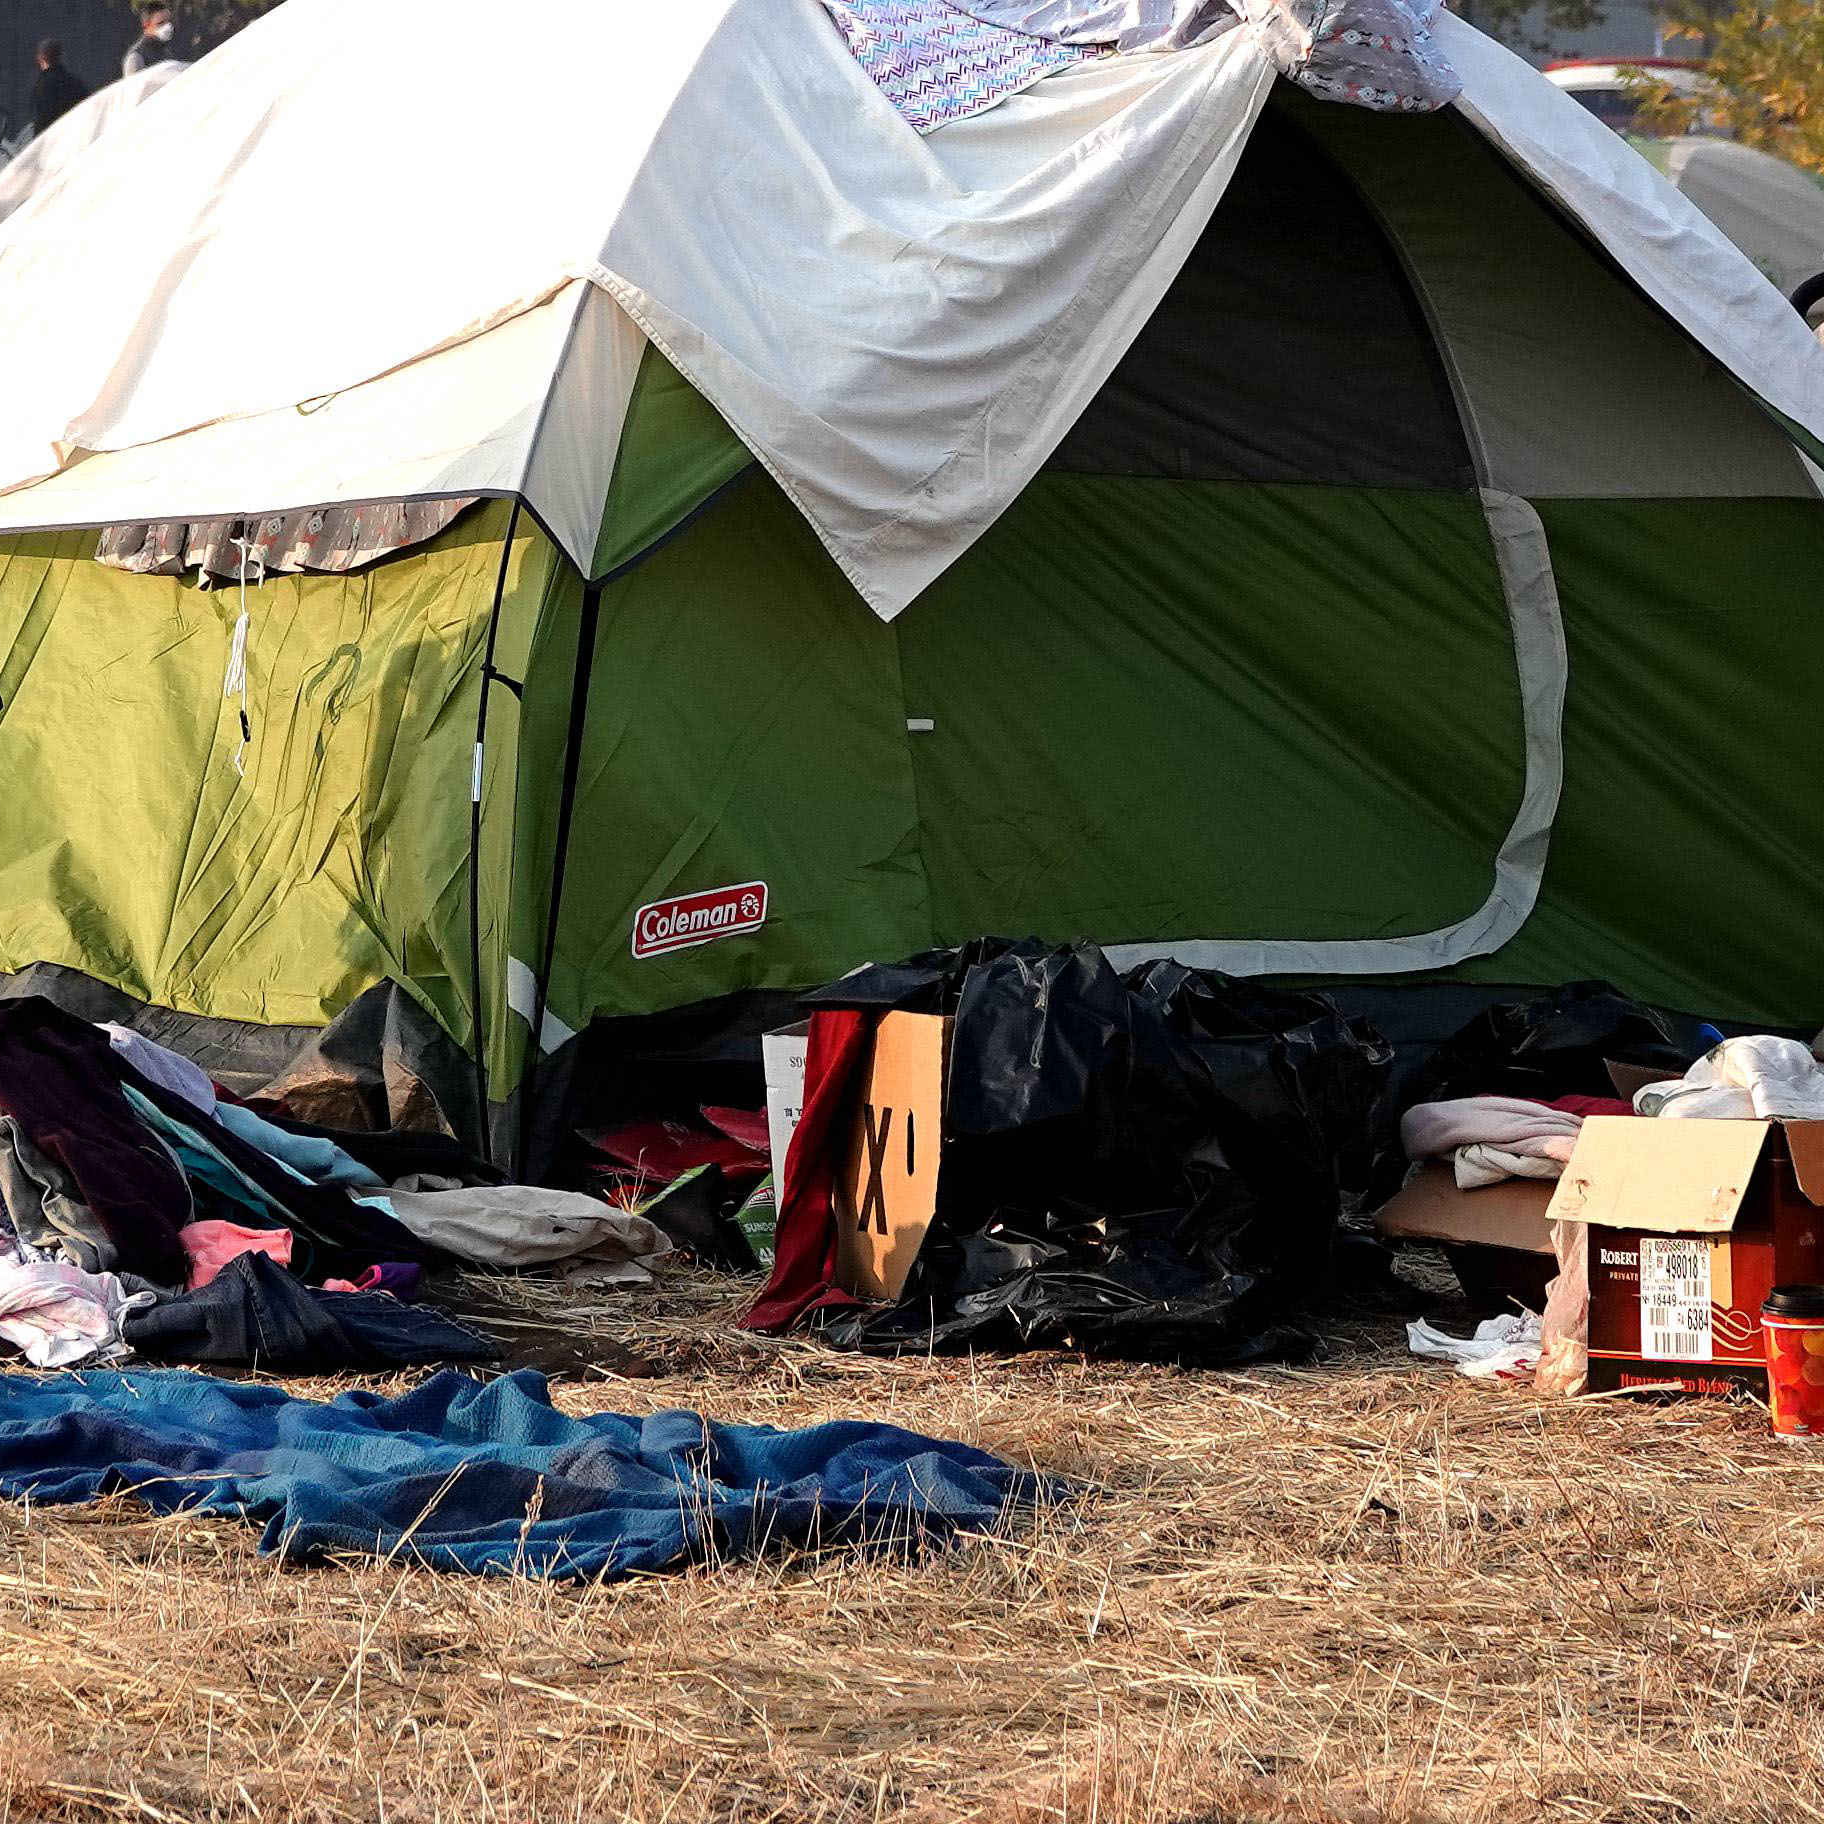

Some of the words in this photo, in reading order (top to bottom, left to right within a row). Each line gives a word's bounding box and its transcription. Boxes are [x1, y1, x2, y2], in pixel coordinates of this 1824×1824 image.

[642, 902, 737, 942] Coleman
[1600, 1249, 1639, 1266] ROBERT
[1666, 1255, 1699, 1279] 498018
[1687, 1308, 1709, 1331] 6384
